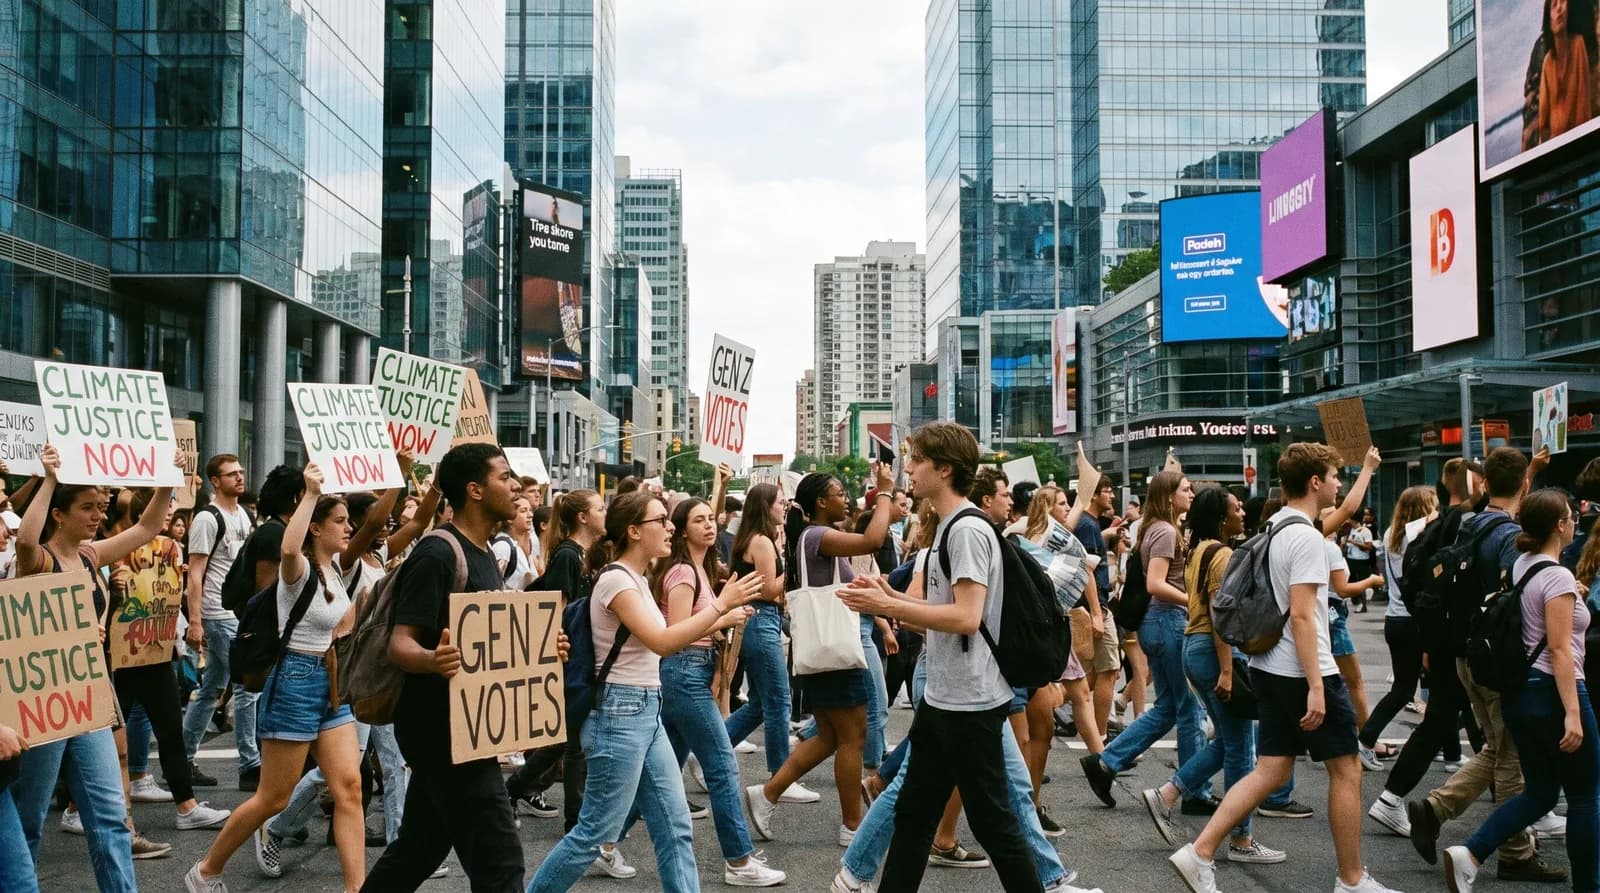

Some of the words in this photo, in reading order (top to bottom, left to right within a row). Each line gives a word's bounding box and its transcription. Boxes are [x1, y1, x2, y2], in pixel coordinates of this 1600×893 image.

[530, 236, 546, 249] you
[42, 365, 164, 406] CLIMATE
[381, 353, 462, 397] CLIMATE
[712, 345, 742, 392] GEN
[740, 356, 754, 395] Z
[52, 404, 169, 441] JUSTICE
[297, 388, 379, 417] CLIMATE
[705, 390, 748, 454] VOTES
[308, 422, 390, 451] JUSTICE
[388, 421, 437, 455] NOW
[83, 443, 155, 477] NOW
[333, 453, 384, 486] NOW
[0, 584, 91, 641] IMATE
[457, 602, 530, 674] GEN
[537, 601, 558, 665] Z
[18, 685, 93, 740] NOW
[460, 671, 562, 750] VOTES
